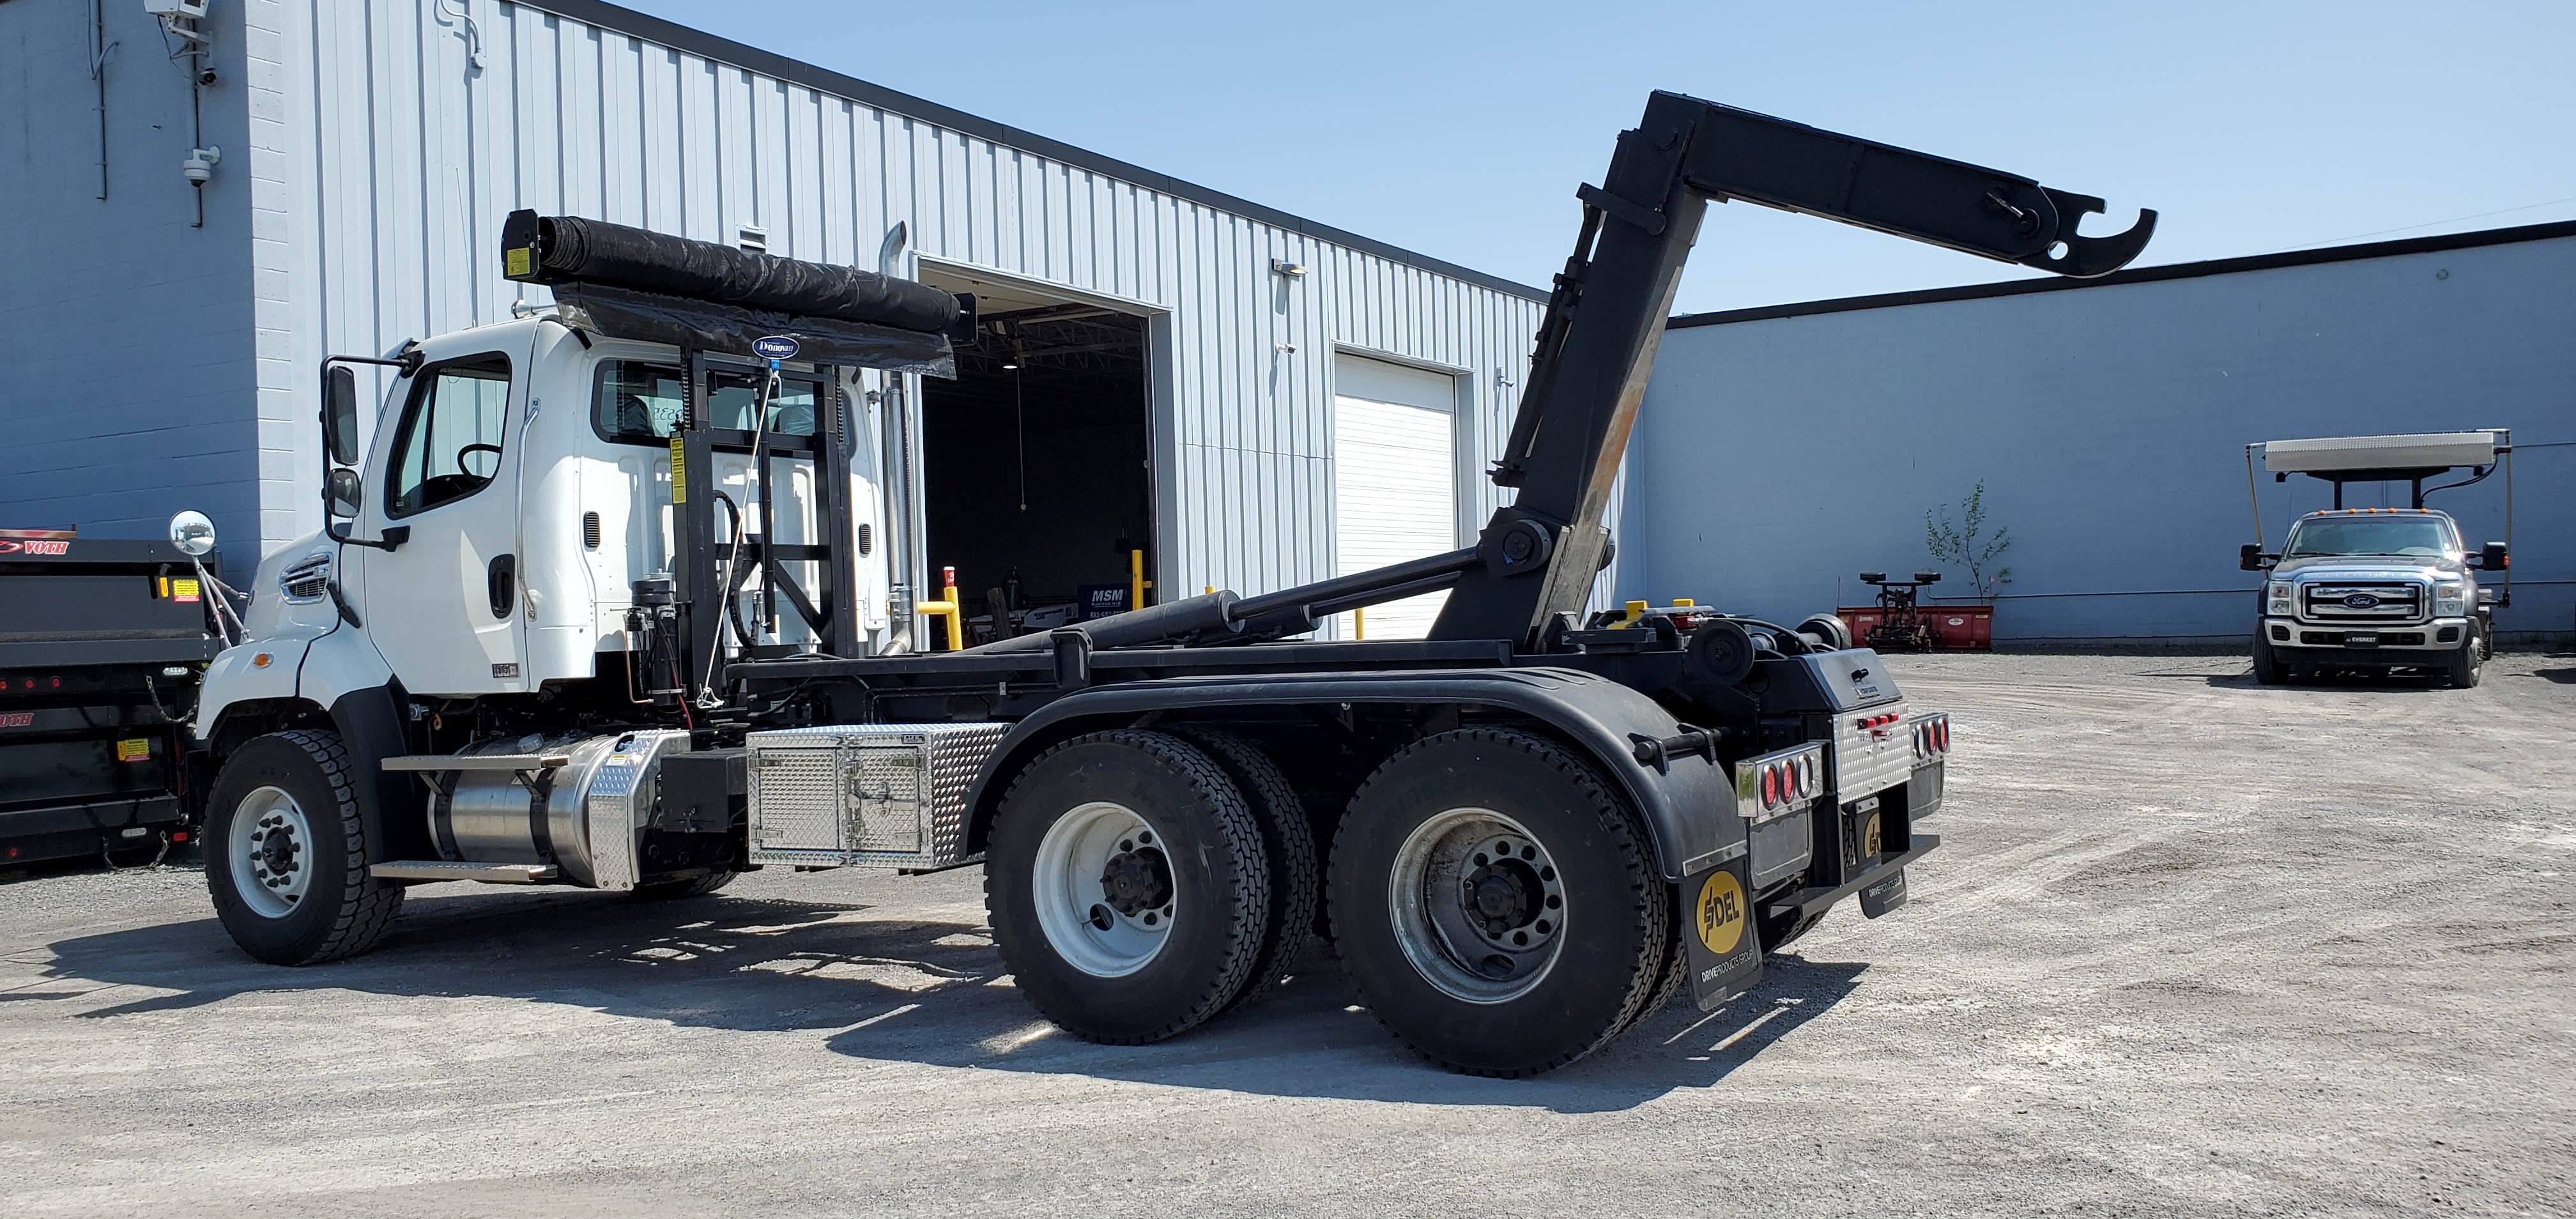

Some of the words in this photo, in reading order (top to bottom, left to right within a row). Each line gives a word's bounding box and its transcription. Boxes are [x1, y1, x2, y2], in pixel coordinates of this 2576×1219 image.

[758, 341, 793, 352] Donovan
[24, 540, 70, 555] VOTH
[1091, 589, 1124, 602] MSM
[0, 713, 34, 727] OTH
[1739, 949, 1753, 965] GROUP
